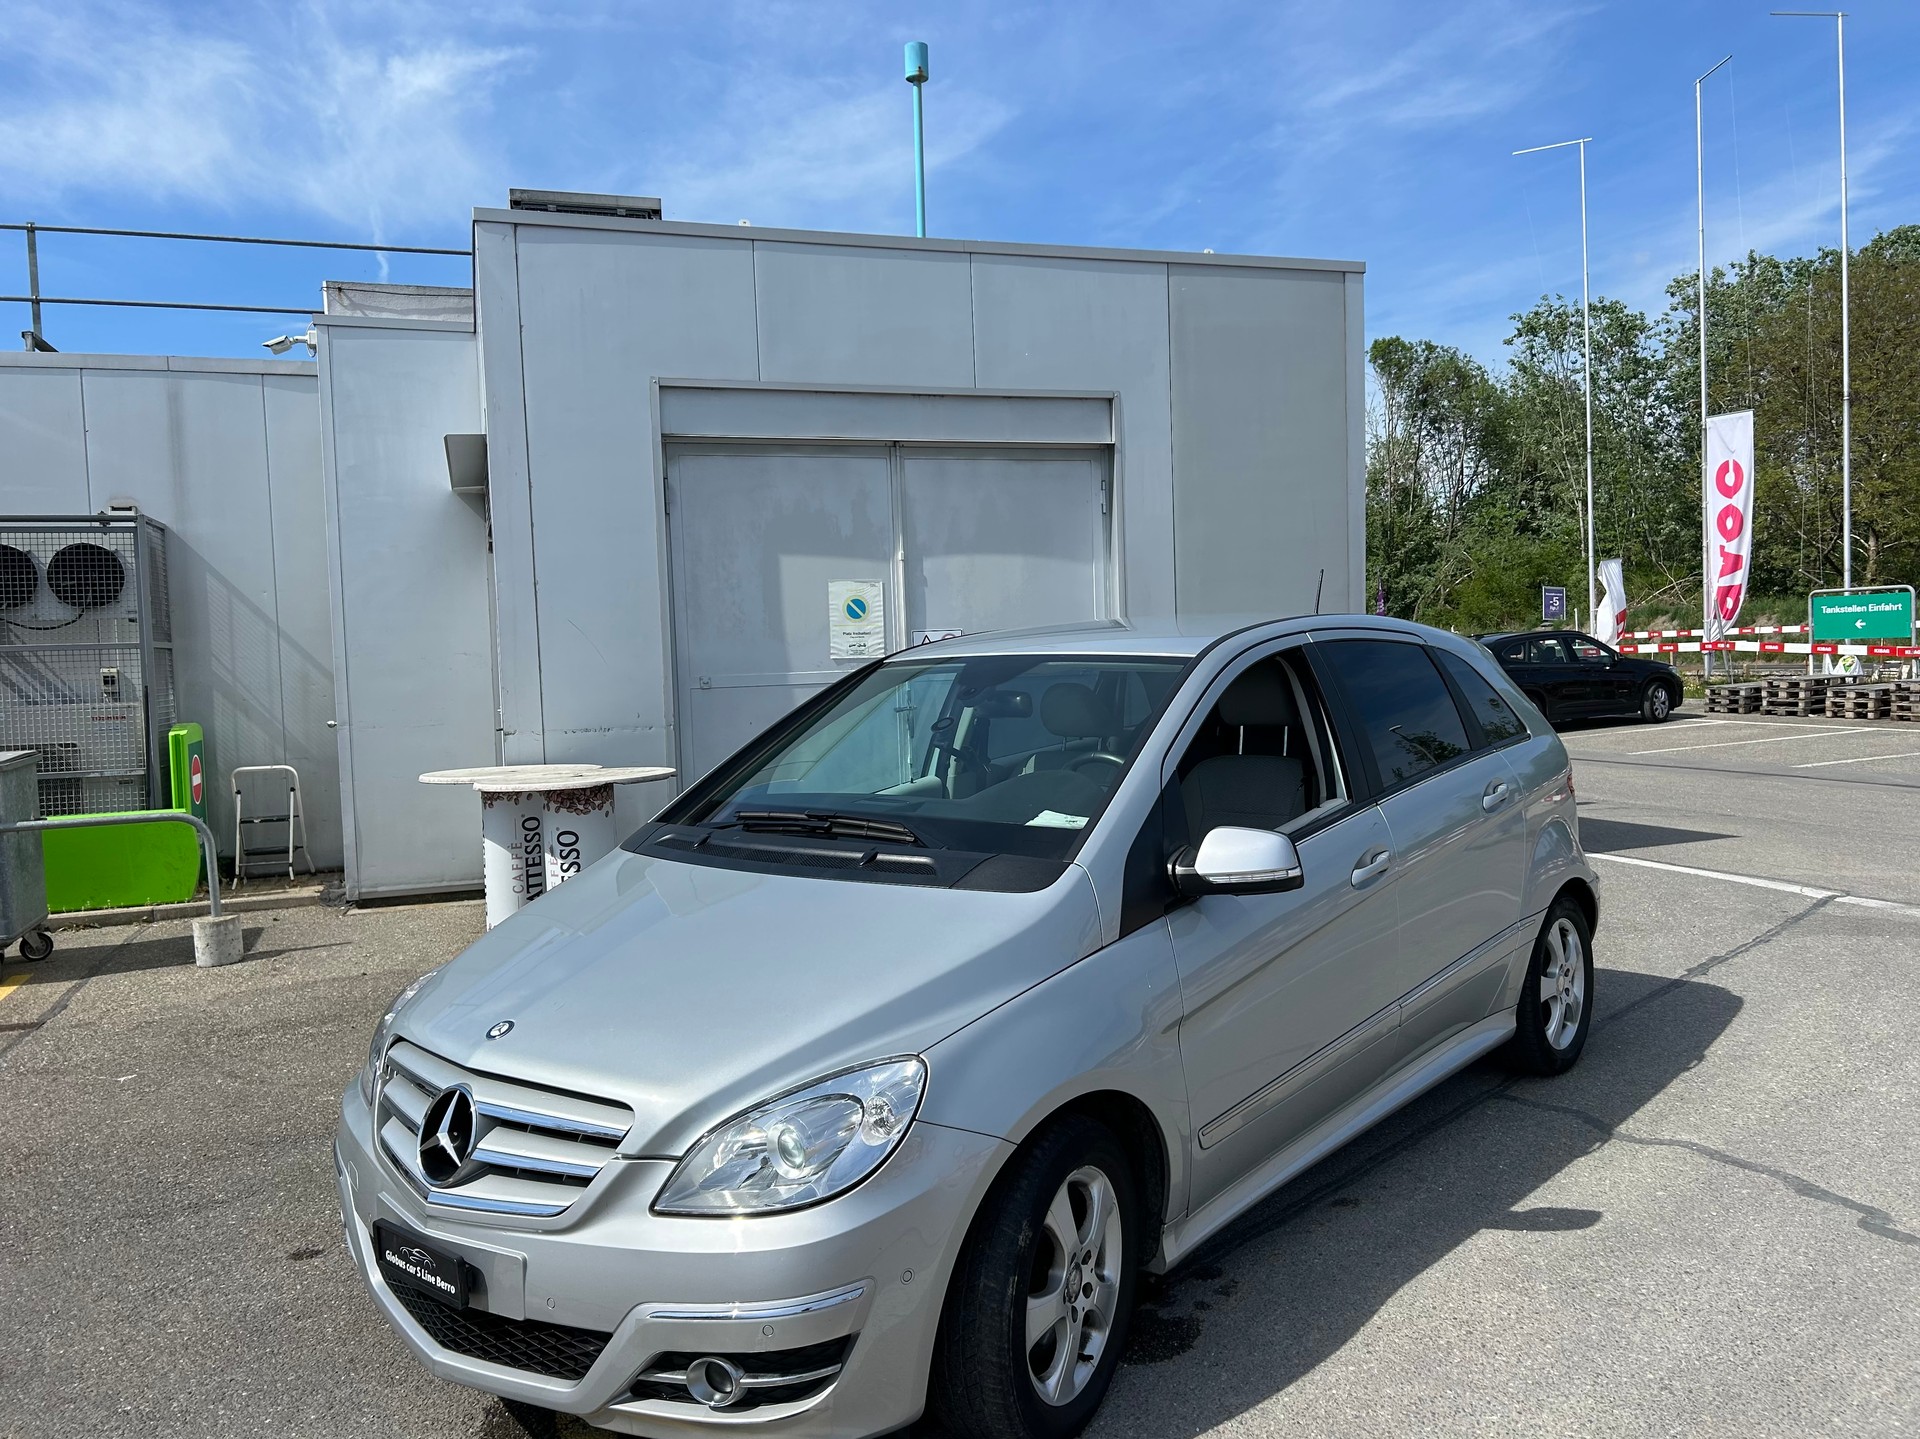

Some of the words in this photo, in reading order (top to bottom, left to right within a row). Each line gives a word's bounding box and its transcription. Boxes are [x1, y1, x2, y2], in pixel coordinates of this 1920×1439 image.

[1821, 604, 1867, 614] Tankstellen
[1868, 603, 1903, 612] Einfahrt
[508, 842, 524, 894] CAFFÈ
[521, 816, 543, 901] ATTESSO
[385, 1250, 405, 1270] Globus
[406, 1263, 416, 1275] car
[416, 1266, 421, 1277] S
[421, 1268, 436, 1285] Line
[436, 1275, 455, 1294] Berro
